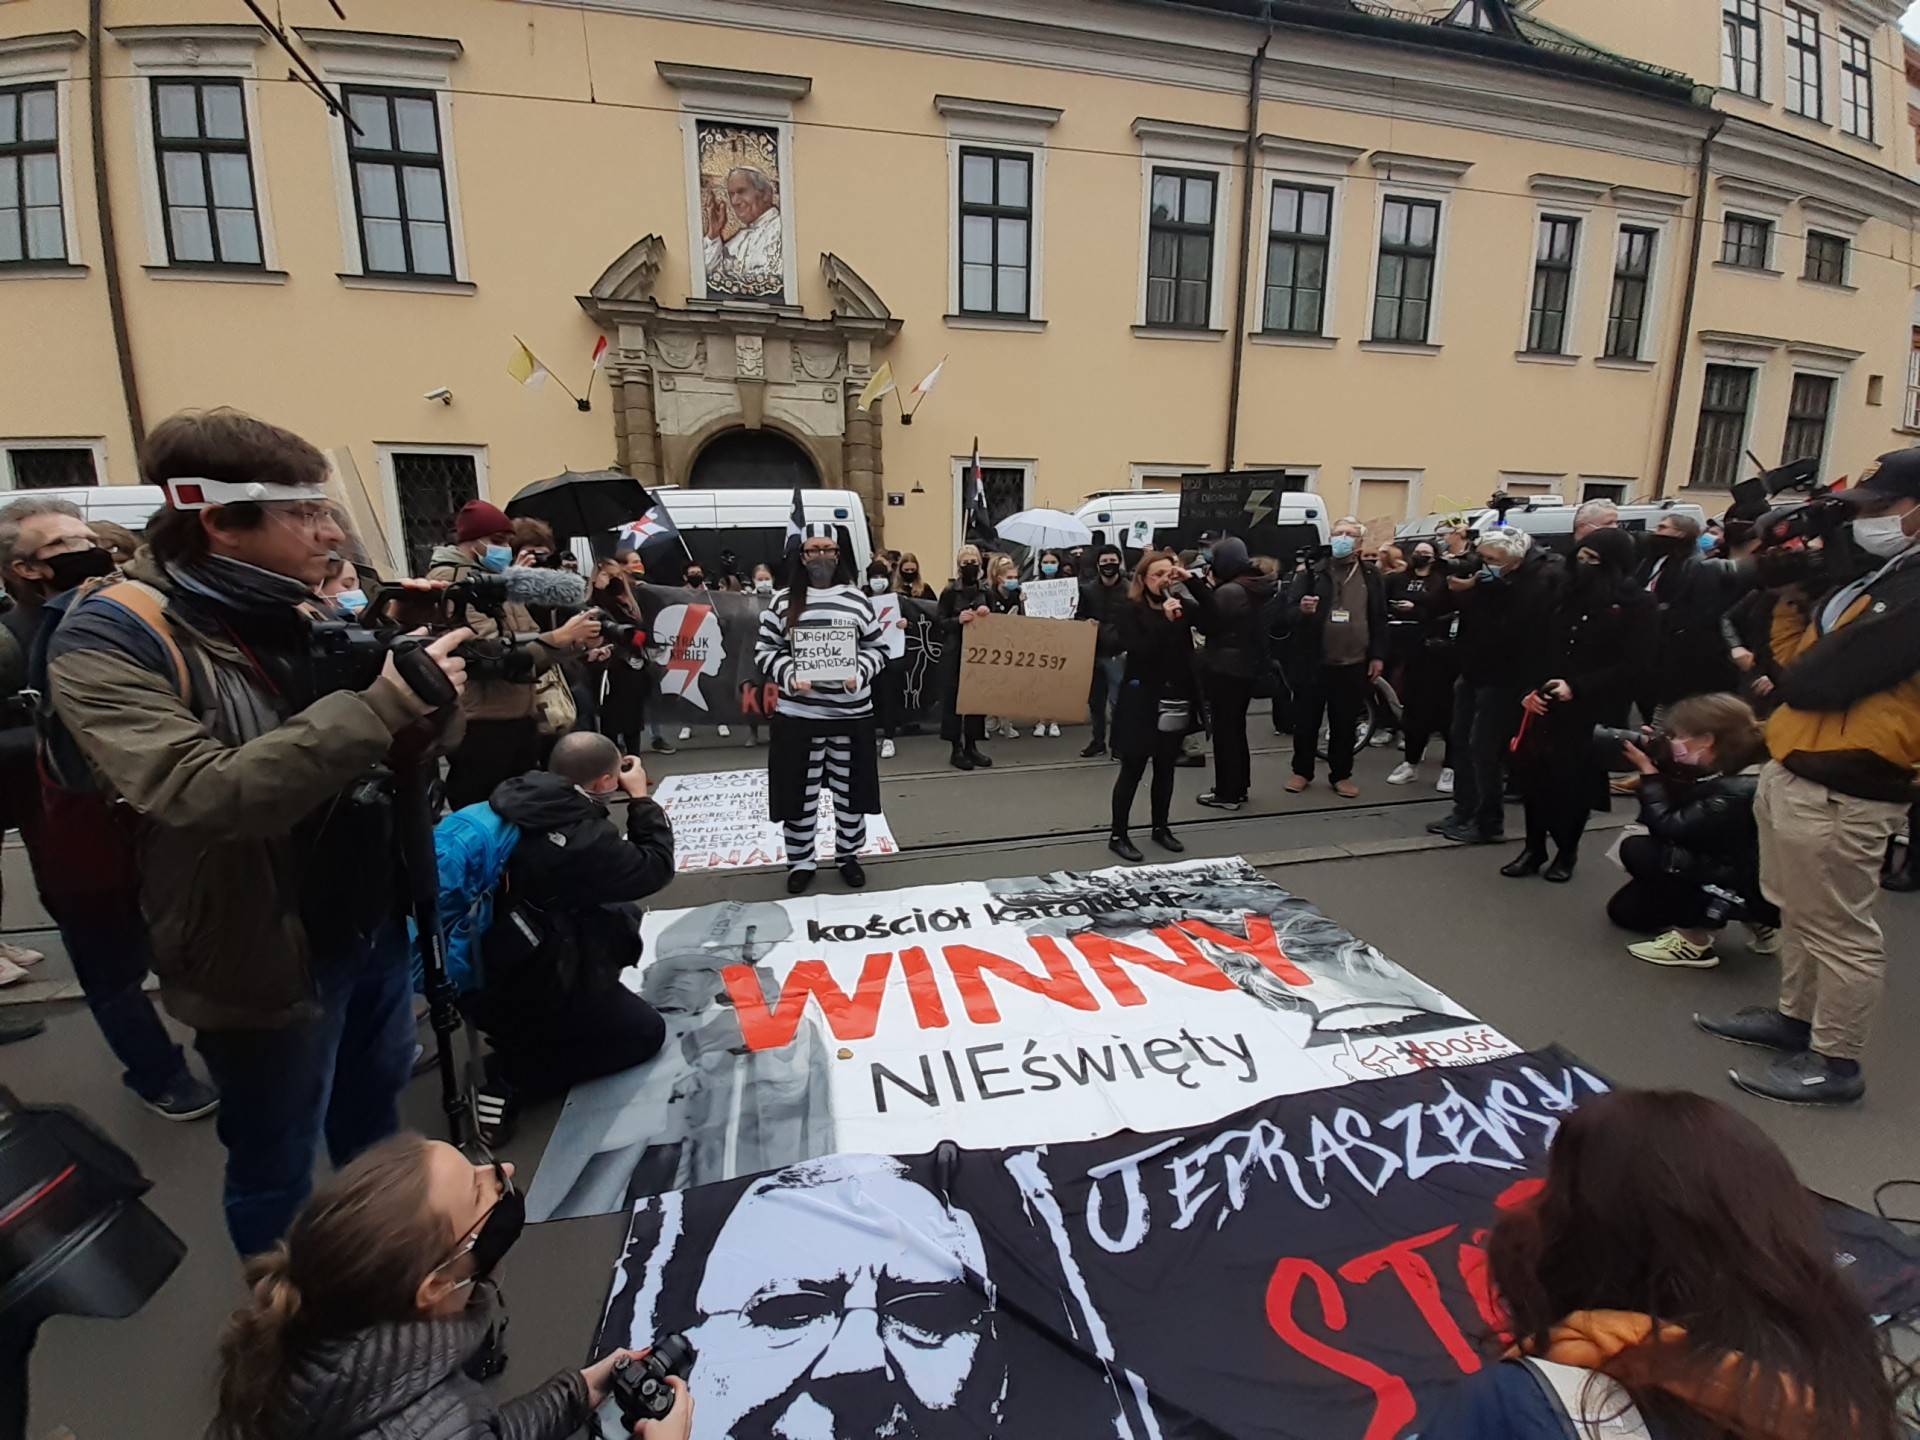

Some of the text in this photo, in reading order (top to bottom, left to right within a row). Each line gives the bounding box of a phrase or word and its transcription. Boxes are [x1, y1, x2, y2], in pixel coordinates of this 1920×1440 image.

[893, 496, 900, 505] 3
[669, 635, 709, 649] STRAJK
[795, 630, 854, 642] DIAGNOZA
[670, 650, 708, 661] KOBIET
[795, 657, 855, 671] EDWARDSA
[807, 882, 1198, 944] kościół katolicki
[720, 912, 1313, 1052] WINNY
[870, 1026, 1258, 1113] NIEświęty
